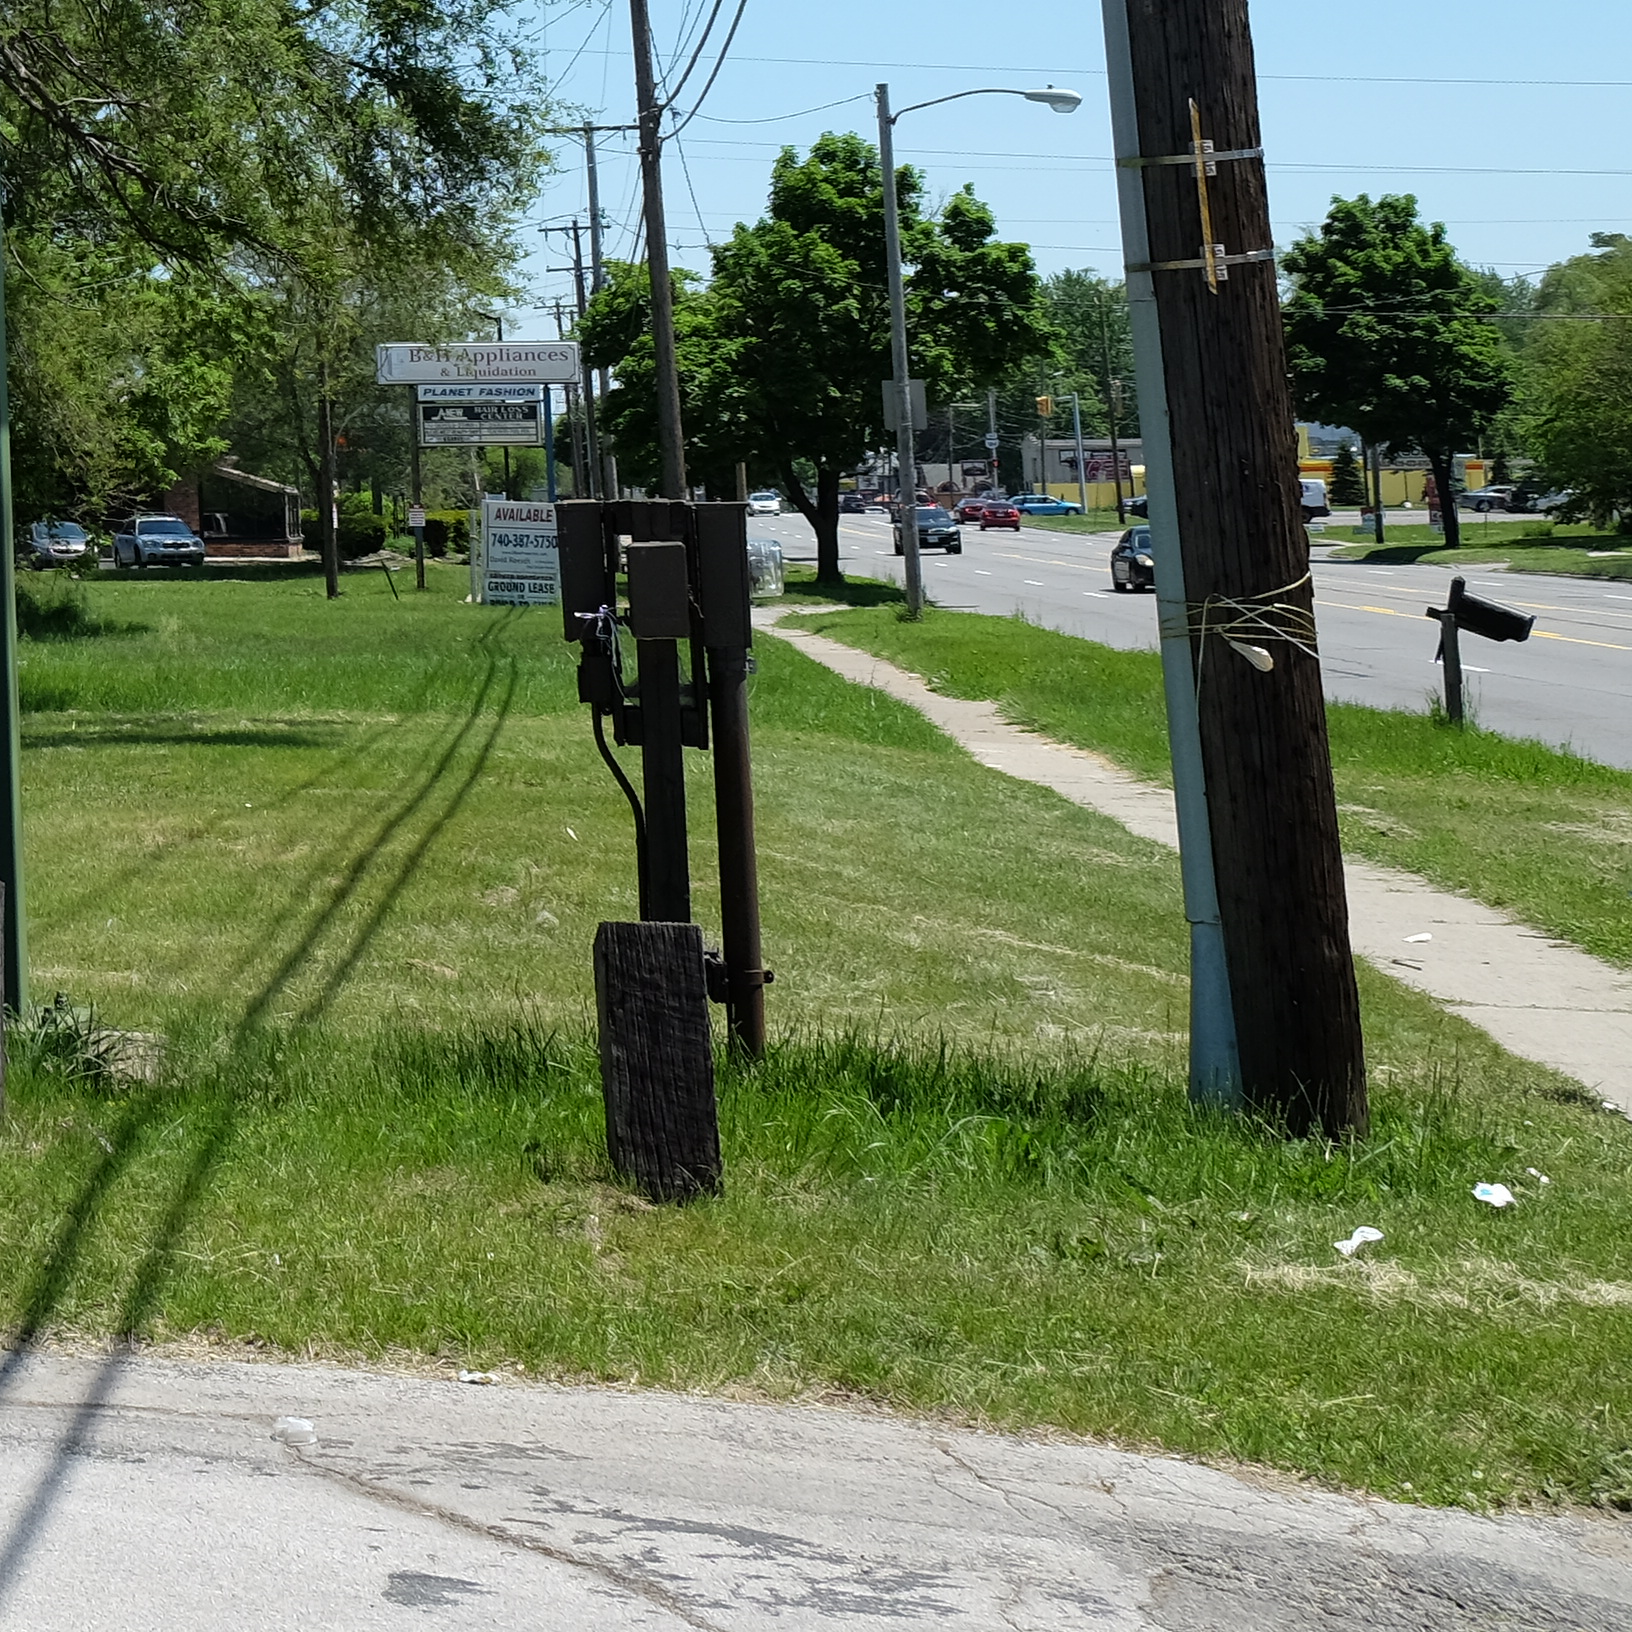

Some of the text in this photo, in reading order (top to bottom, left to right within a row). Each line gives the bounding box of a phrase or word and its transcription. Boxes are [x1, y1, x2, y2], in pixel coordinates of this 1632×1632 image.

[455, 348, 569, 366] Appliances
[440, 366, 537, 379] & Liquidation
[422, 387, 536, 397] PLANET FASHION
[494, 507, 554, 522] AVAILABLE
[487, 581, 555, 594] GROUND LEASE
